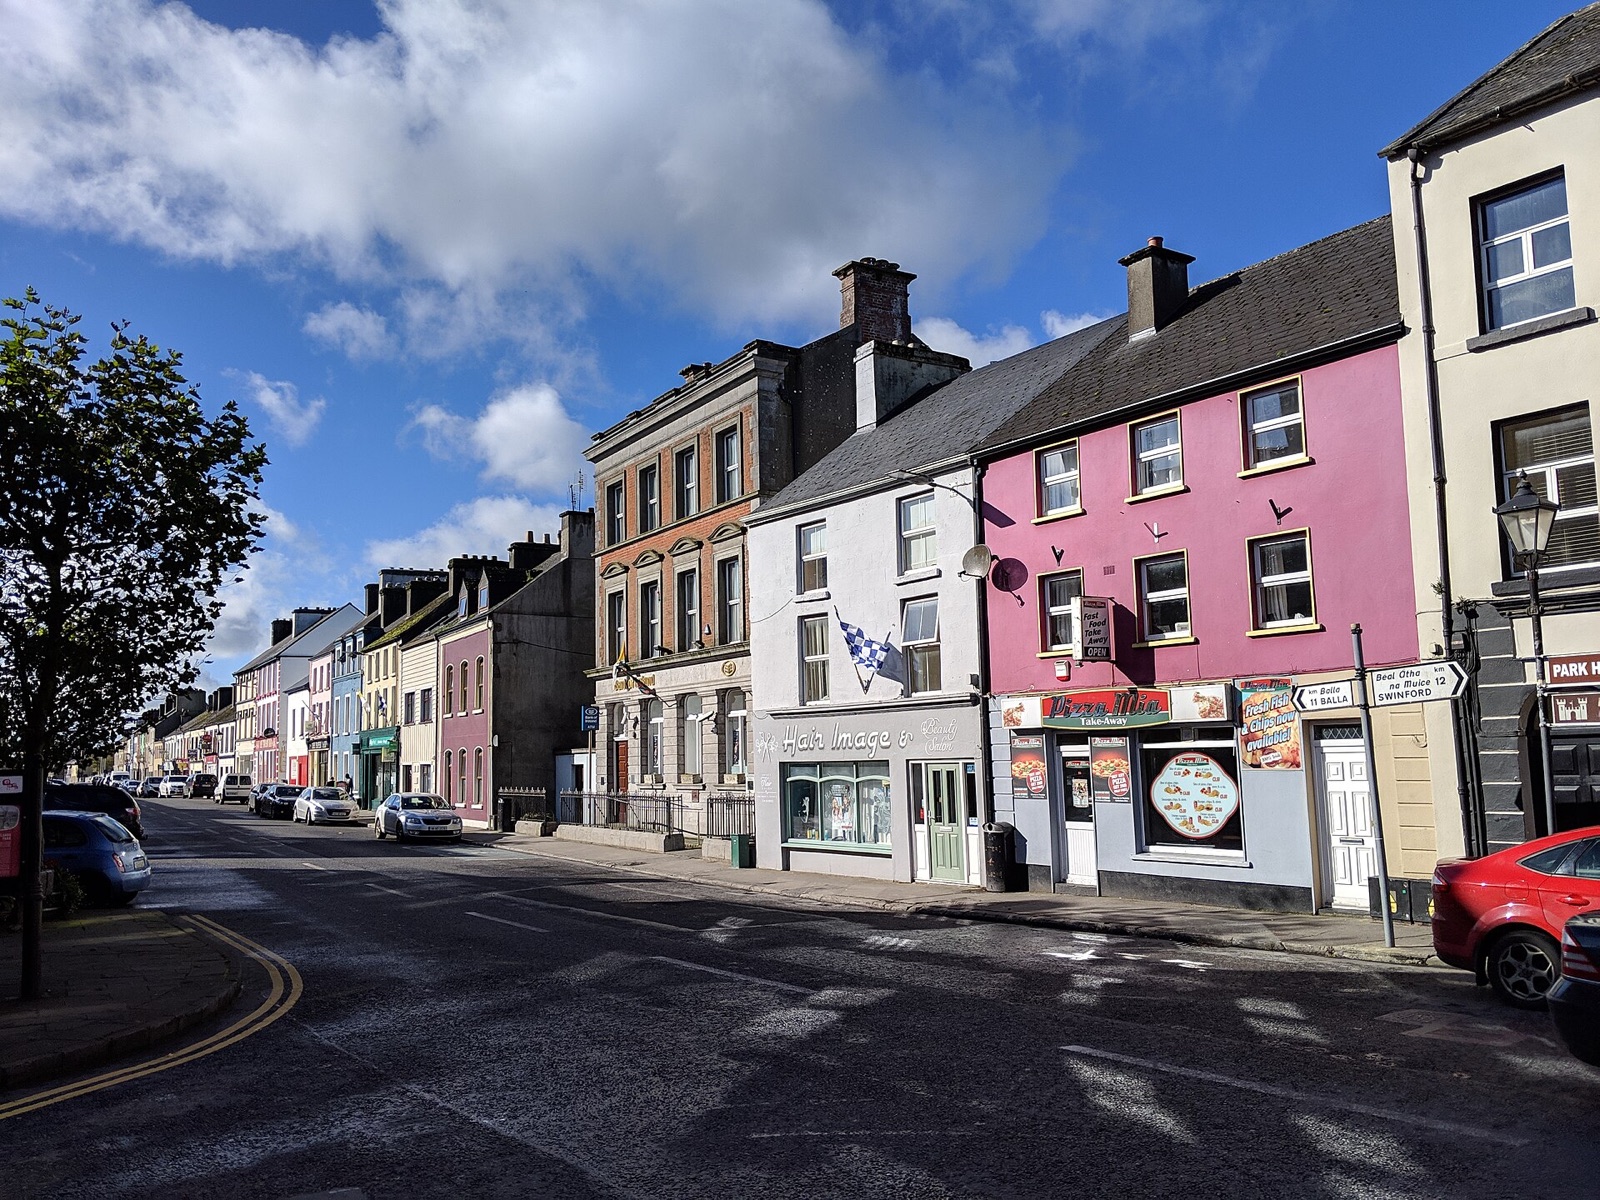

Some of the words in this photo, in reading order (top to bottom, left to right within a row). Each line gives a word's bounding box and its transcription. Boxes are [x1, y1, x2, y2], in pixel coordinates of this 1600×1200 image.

[1083, 612, 1099, 621] Fast
[1088, 618, 1107, 628] Food
[1084, 628, 1102, 637] Take
[1087, 636, 1108, 645] Away
[1087, 647, 1107, 657] OPEN
[1553, 662, 1588, 678] PARK
[1404, 679, 1431, 689] Muice
[1435, 676, 1446, 686] 12
[1320, 686, 1340, 695] Balla
[1378, 688, 1432, 701] SWINFORD
[1049, 695, 1109, 718] Pizza
[1112, 691, 1162, 717] Mia
[1245, 699, 1270, 718] Fresh
[1270, 692, 1289, 711] Fish
[1310, 698, 1318, 706] 11
[1321, 695, 1348, 705] BALLA
[1080, 717, 1128, 726] Take-Away
[1241, 725, 1249, 736] &
[1249, 716, 1275, 733] Chips
[1275, 710, 1296, 726] now
[920, 717, 959, 740] Beauty
[782, 724, 825, 757] Hair
[831, 722, 891, 759] Image
[1246, 727, 1292, 752] available!
[924, 736, 955, 755] Salon
